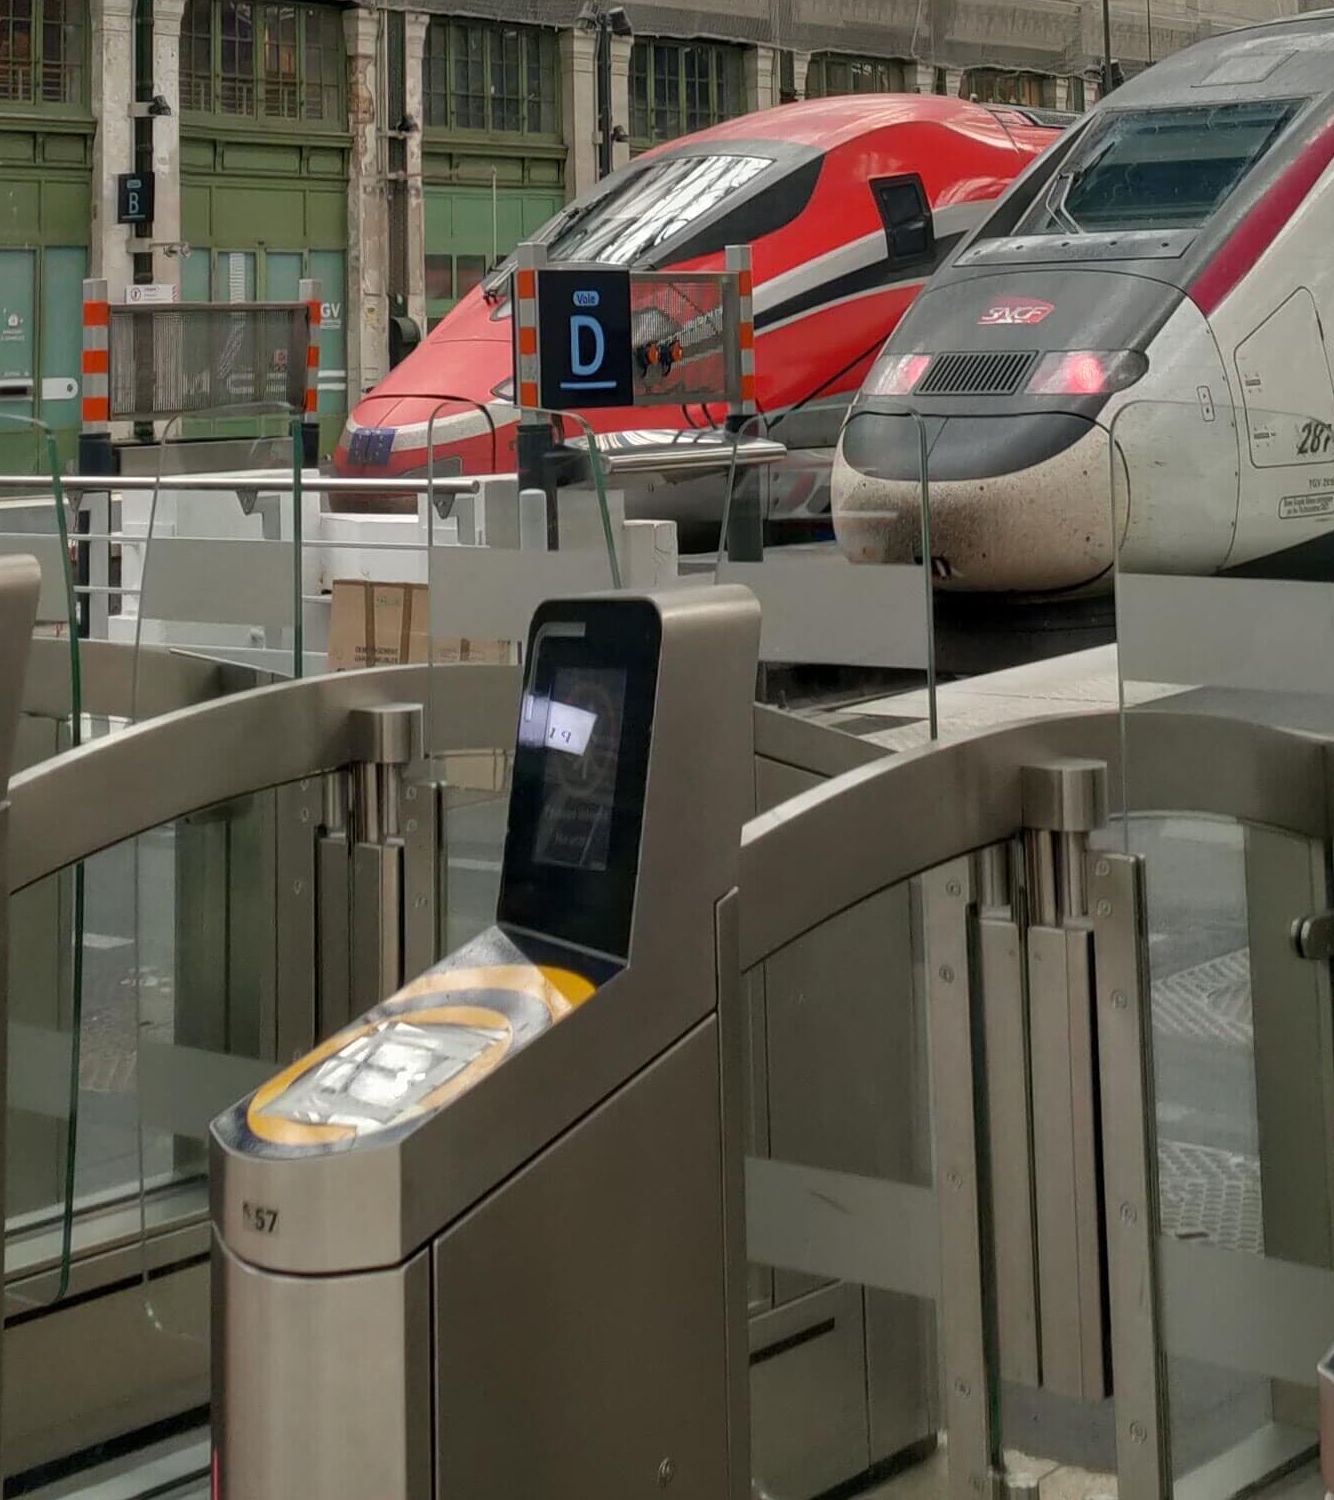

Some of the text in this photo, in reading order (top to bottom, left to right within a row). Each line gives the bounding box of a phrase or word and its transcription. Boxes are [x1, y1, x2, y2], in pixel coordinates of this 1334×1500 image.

[129, 192, 139, 214] B
[570, 315, 605, 376] D
[255, 1206, 280, 1234] 57
